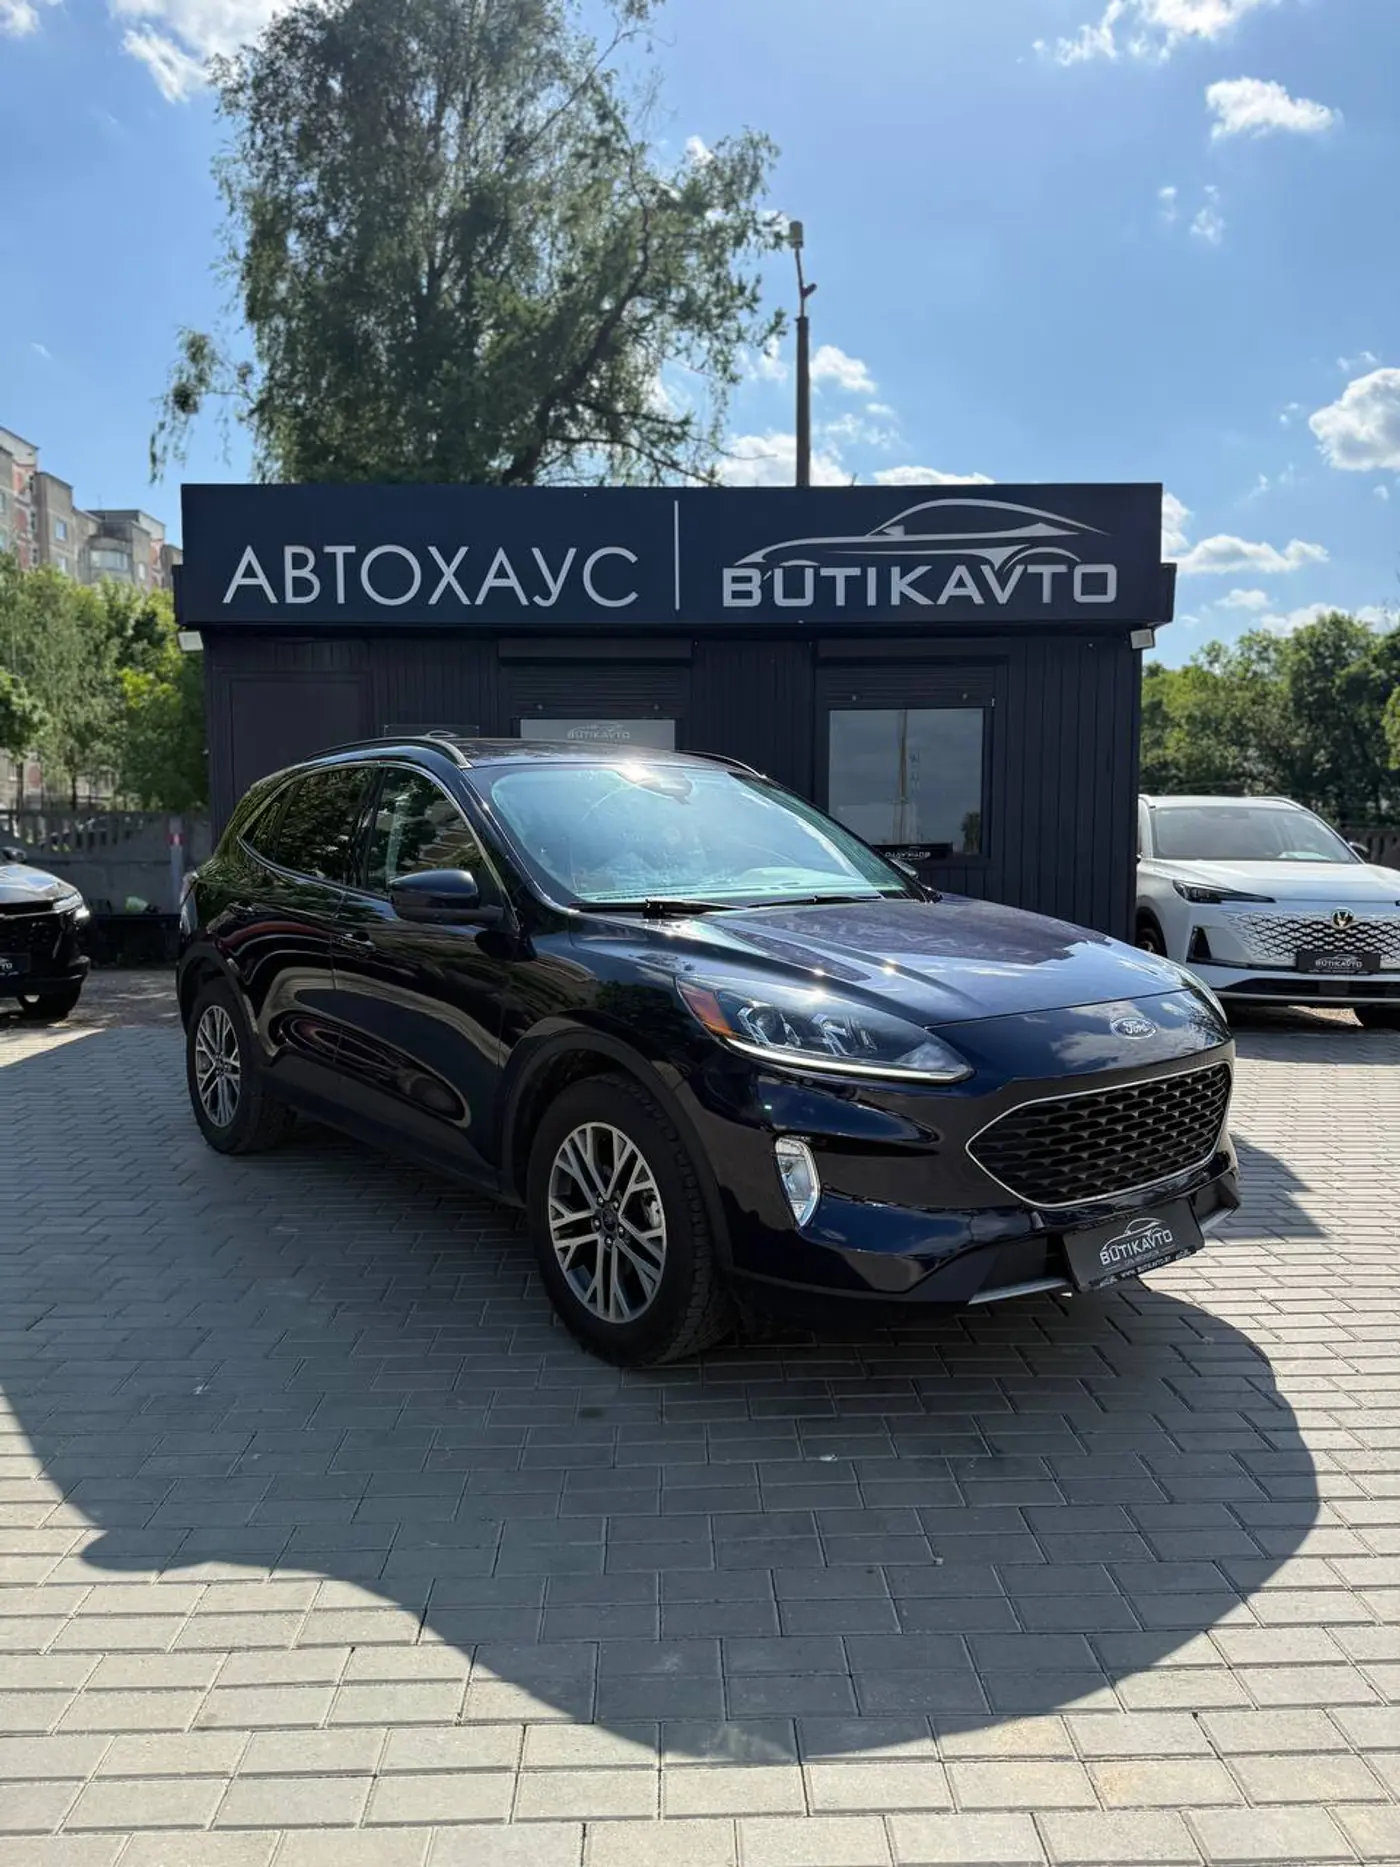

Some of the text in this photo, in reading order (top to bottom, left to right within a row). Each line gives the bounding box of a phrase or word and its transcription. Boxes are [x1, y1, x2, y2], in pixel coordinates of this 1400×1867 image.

[223, 544, 639, 607] АВТОХАУС
[722, 564, 1118, 607] BUTIKAVTO
[1100, 1229, 1173, 1265] BUTIKAVTO
